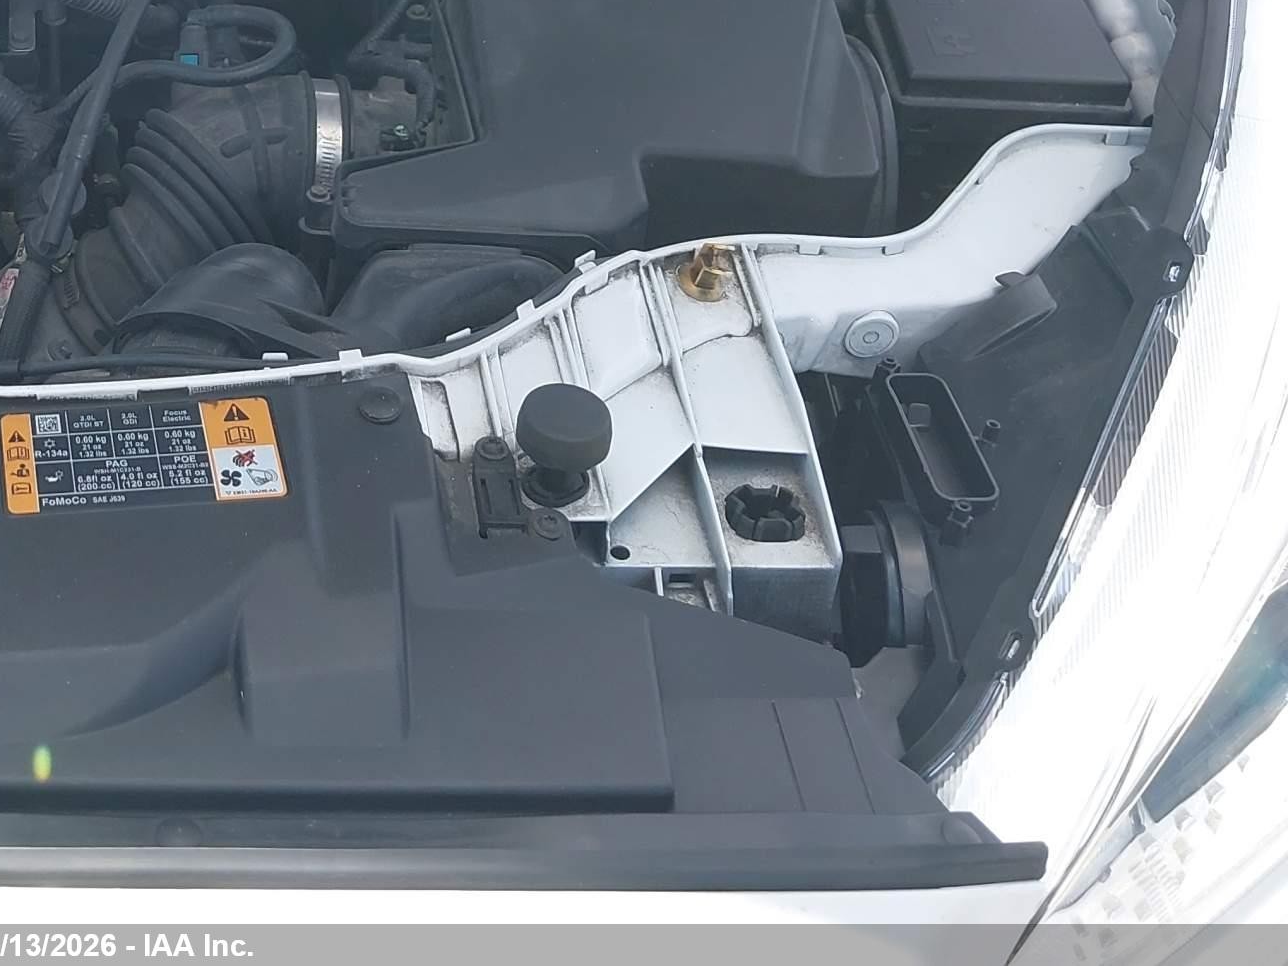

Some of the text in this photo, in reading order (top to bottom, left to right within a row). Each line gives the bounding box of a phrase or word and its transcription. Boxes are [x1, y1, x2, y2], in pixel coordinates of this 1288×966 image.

[95, 434, 107, 444] kg
[137, 432, 149, 441] kg
[164, 430, 196, 439] 0.60 kg
[35, 450, 68, 458] R-134a
[174, 455, 197, 463] POE
[105, 460, 128, 468] PAG
[168, 470, 183, 478] 5.2
[122, 479, 161, 489] (120 cc)
[170, 476, 209, 485] (155 cc)
[78, 481, 116, 492] (200 cc)
[42, 496, 87, 506] FoMoCo
